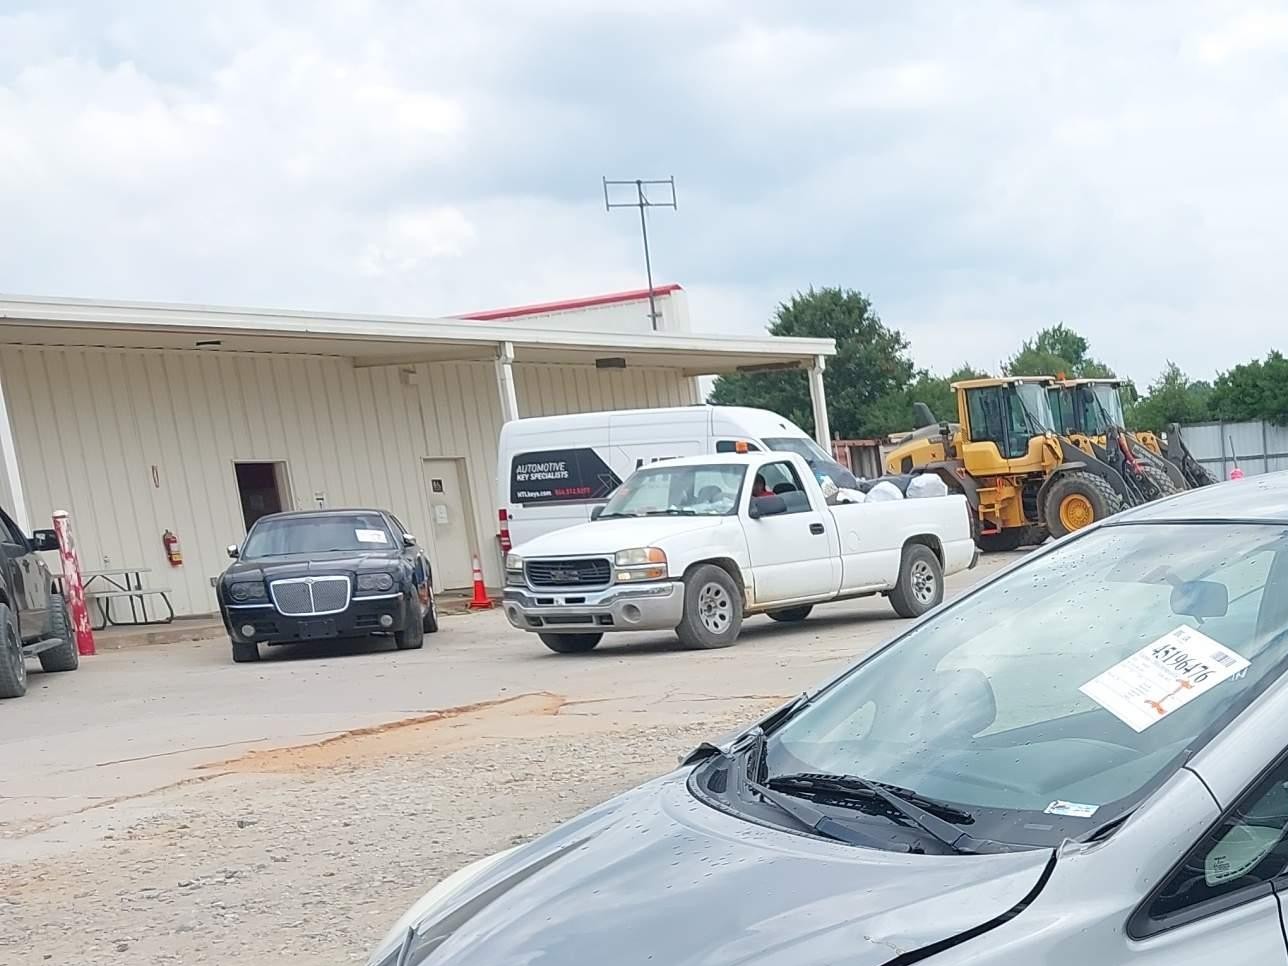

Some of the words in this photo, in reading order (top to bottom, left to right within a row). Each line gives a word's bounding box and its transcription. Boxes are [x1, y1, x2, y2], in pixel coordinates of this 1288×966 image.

[516, 462, 566, 473] AUTOMOTIVE
[517, 473, 529, 481] KEY
[530, 471, 569, 480] SPECIALISTS
[1152, 644, 1217, 683] 45196476
